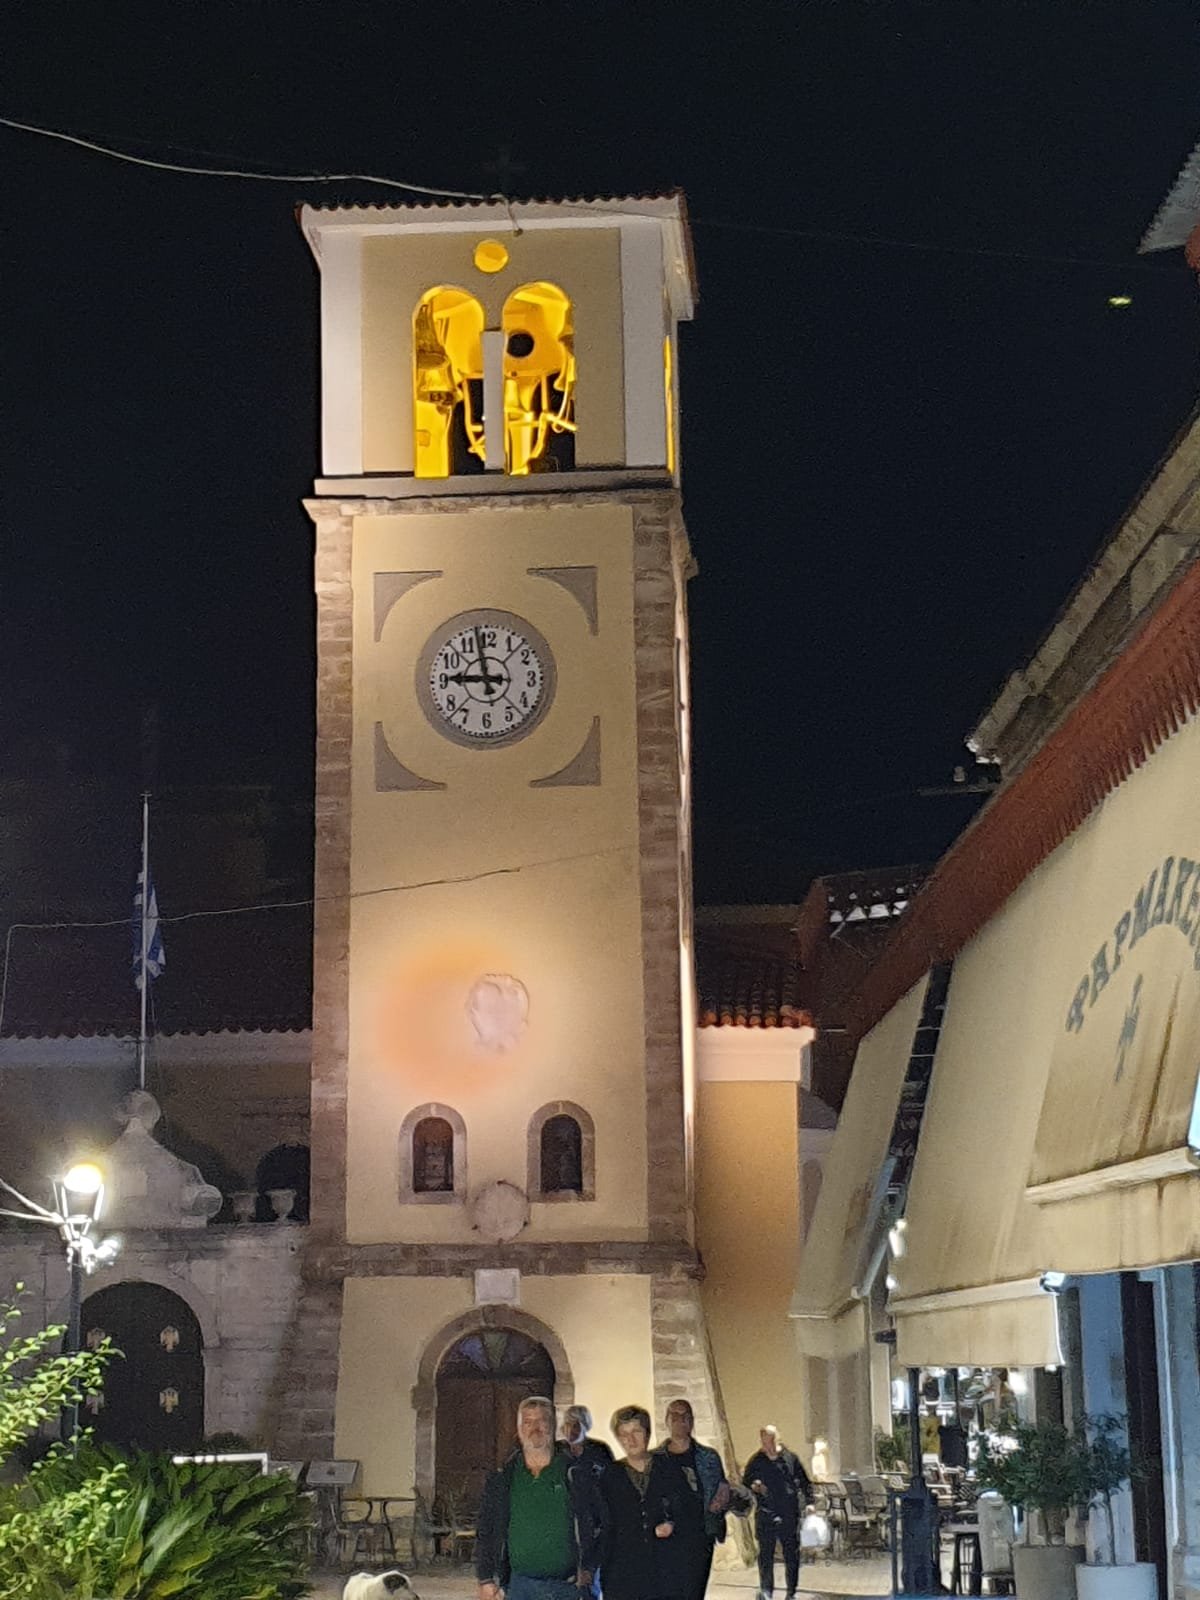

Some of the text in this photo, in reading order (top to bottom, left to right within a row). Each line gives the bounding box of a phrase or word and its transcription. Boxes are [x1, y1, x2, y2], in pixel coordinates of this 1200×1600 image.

[461, 637, 474, 654] 11
[481, 631, 497, 649] 12
[506, 635, 513, 652] 1
[443, 652, 460, 670] 10
[521, 649, 531, 666] 2
[440, 673, 449, 690] 9
[527, 671, 537, 688] 3
[446, 694, 456, 712] 8
[521, 691, 529, 708] 4
[460, 708, 469, 724] 7
[482, 712, 492, 729] 6
[505, 706, 514, 723] 5
[1065, 855, 1200, 1034] ΦΑΡΜΑΚΕ
